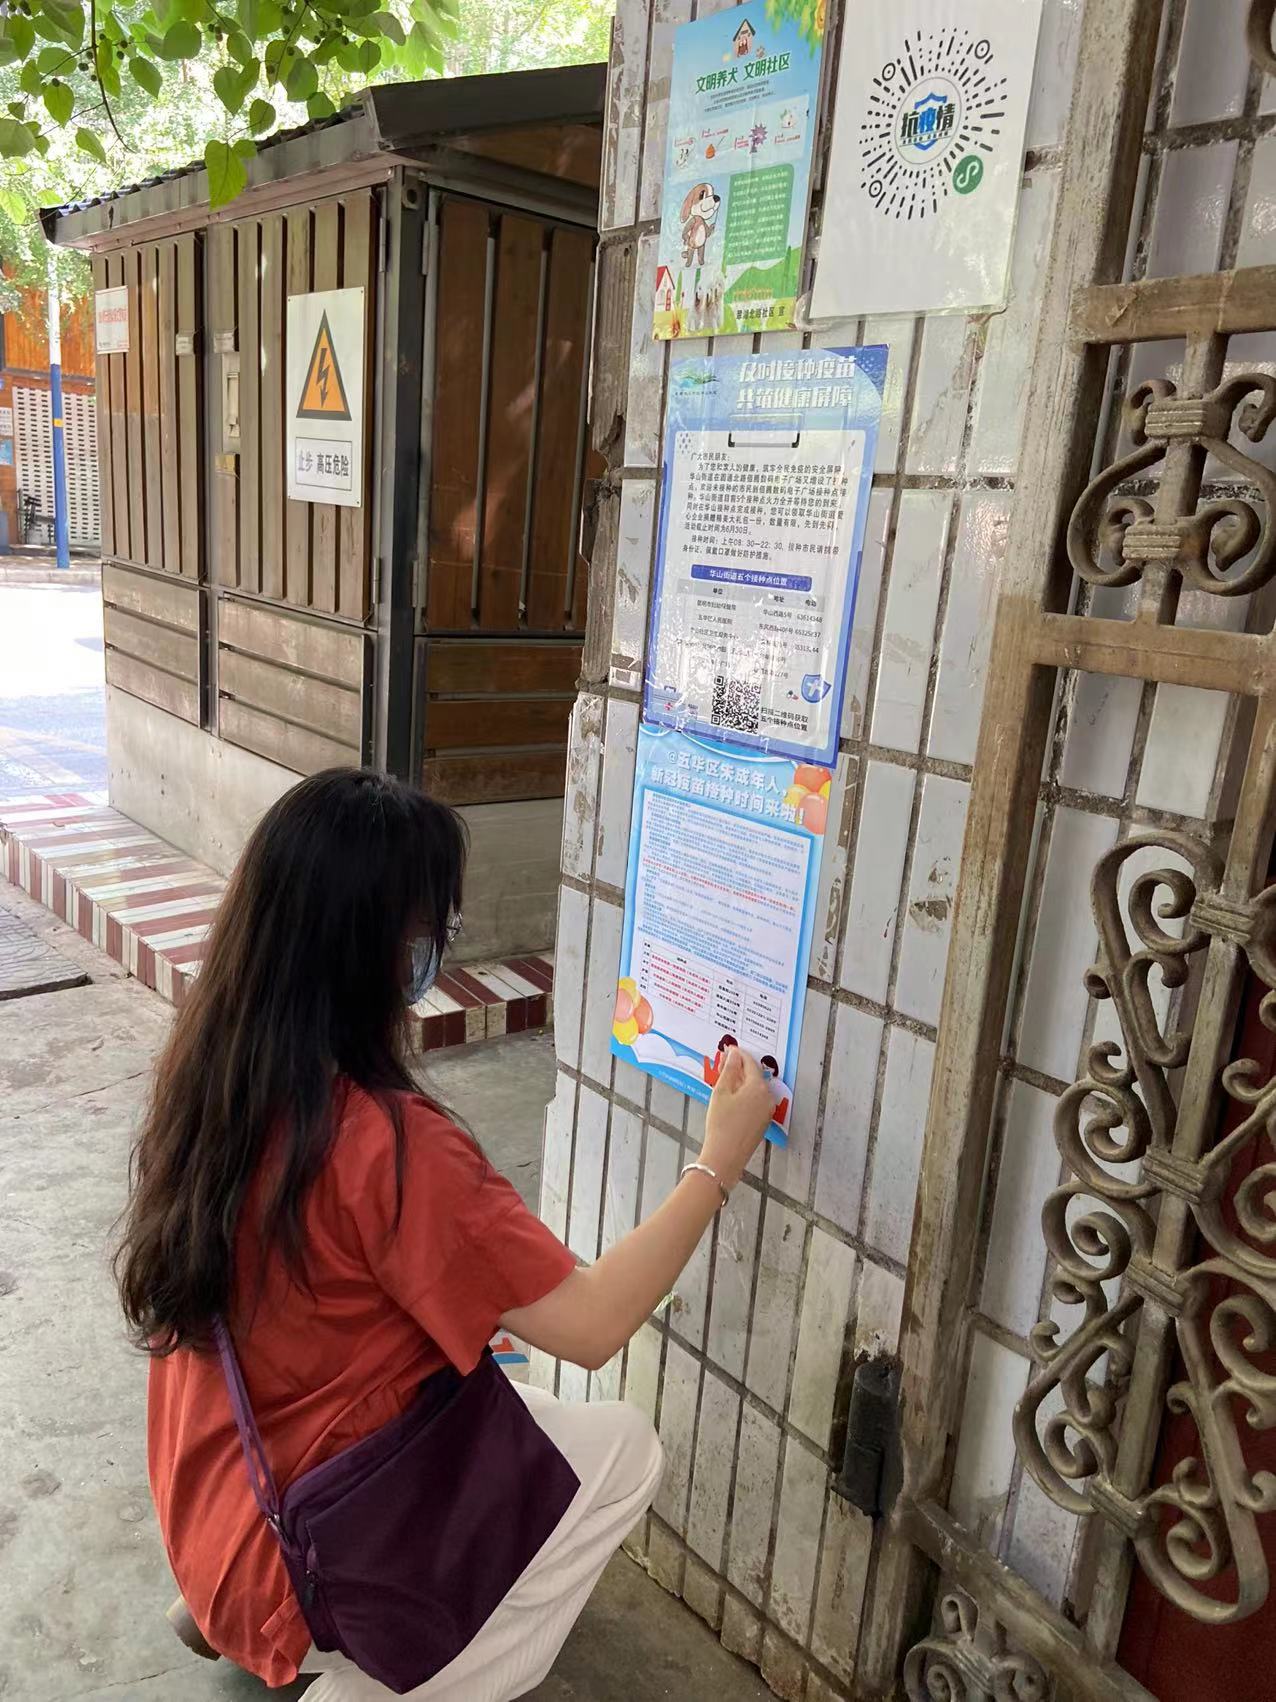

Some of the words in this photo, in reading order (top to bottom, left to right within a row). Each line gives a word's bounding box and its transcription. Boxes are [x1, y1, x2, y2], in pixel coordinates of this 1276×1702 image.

[695, 67, 738, 94] 文明养犬
[743, 52, 790, 80] 文明社区
[739, 355, 857, 382] 及时接种疫苗
[736, 385, 853, 409] 共筑健康屏障
[316, 453, 349, 477] 高压危险
[709, 569, 787, 585] 华山街道五个接种点位置
